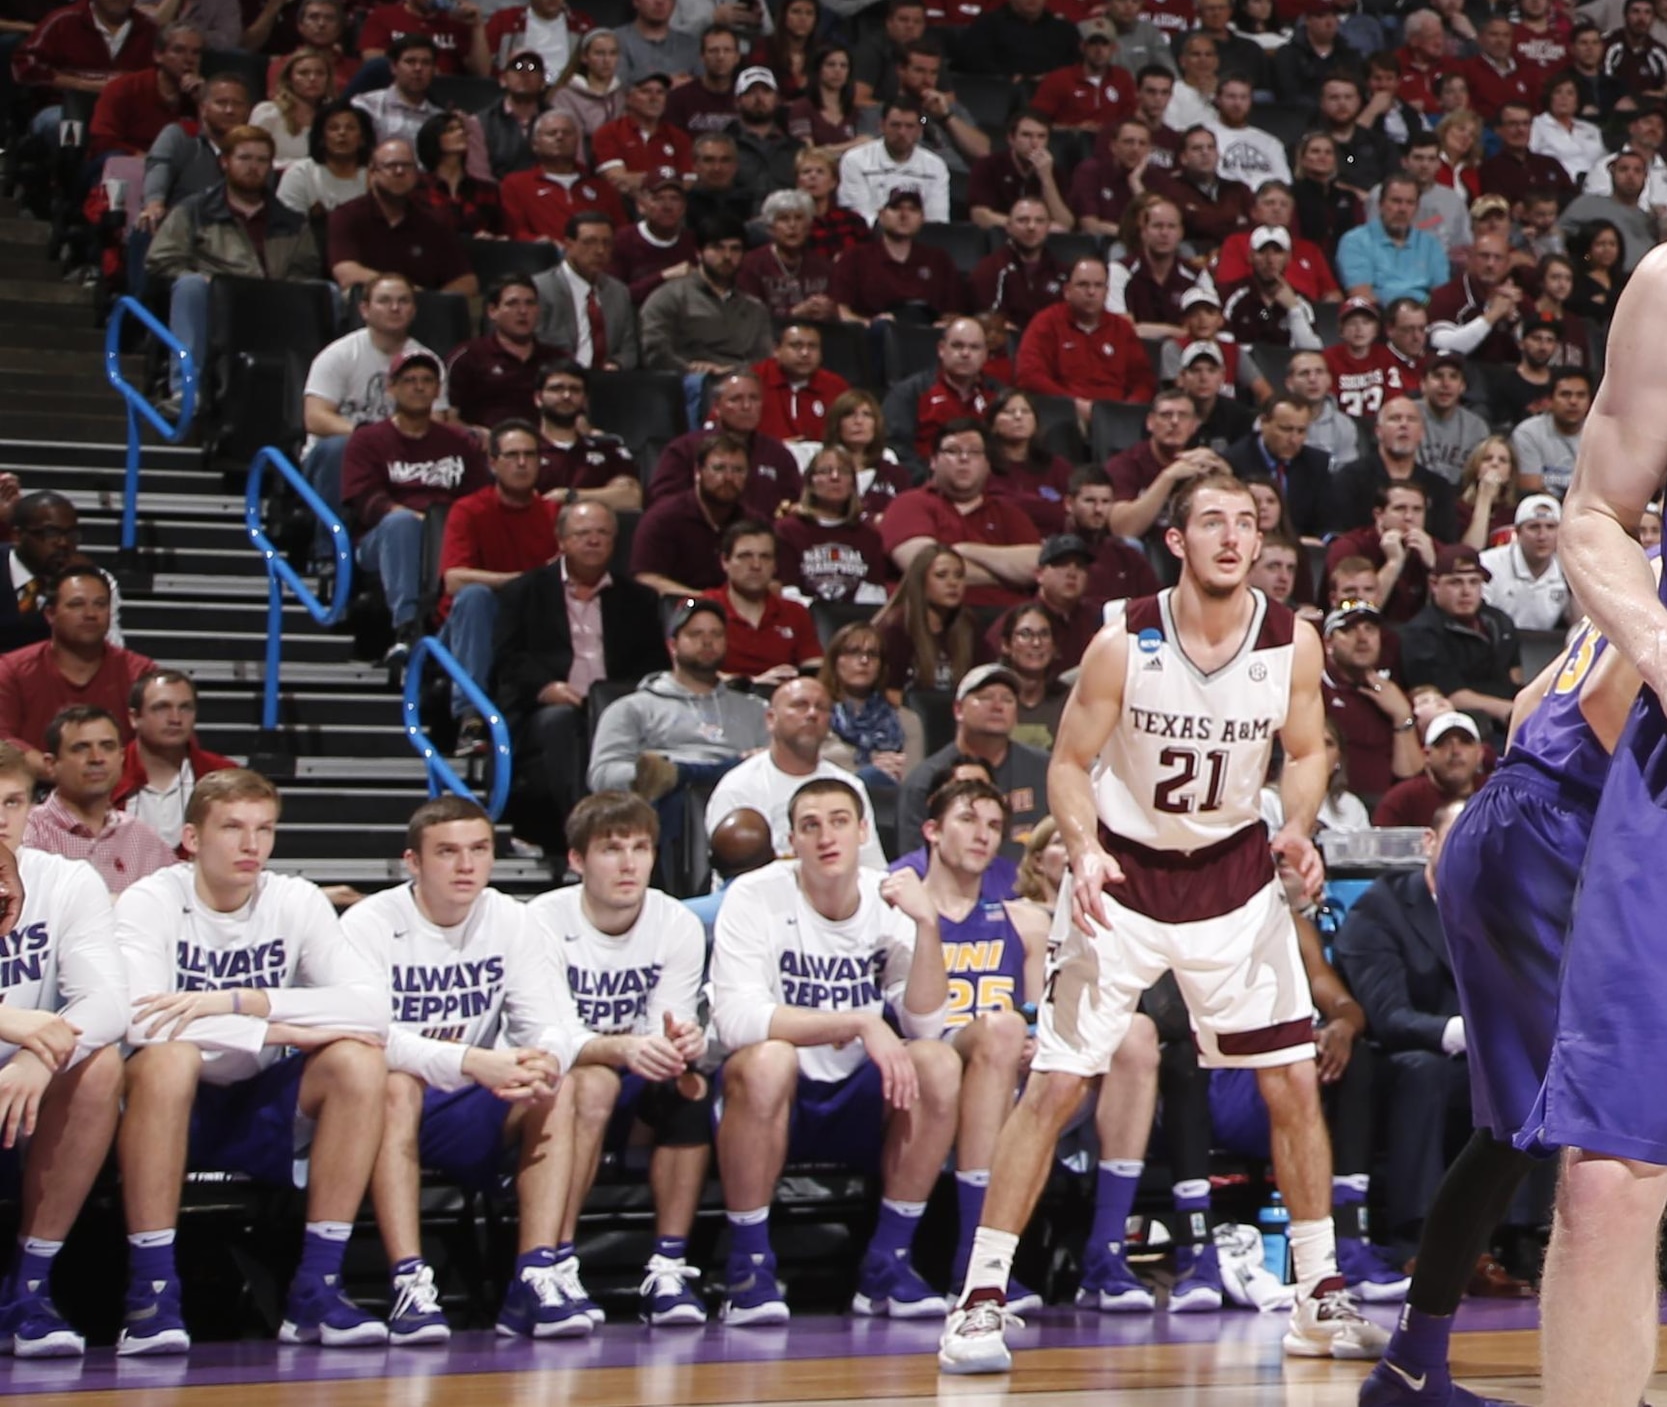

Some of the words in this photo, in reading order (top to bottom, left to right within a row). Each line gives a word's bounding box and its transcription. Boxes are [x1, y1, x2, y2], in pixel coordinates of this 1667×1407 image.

[1129, 706, 1212, 741] TEXAS
[1220, 718, 1273, 743] A&M
[1153, 746, 1230, 815] 21
